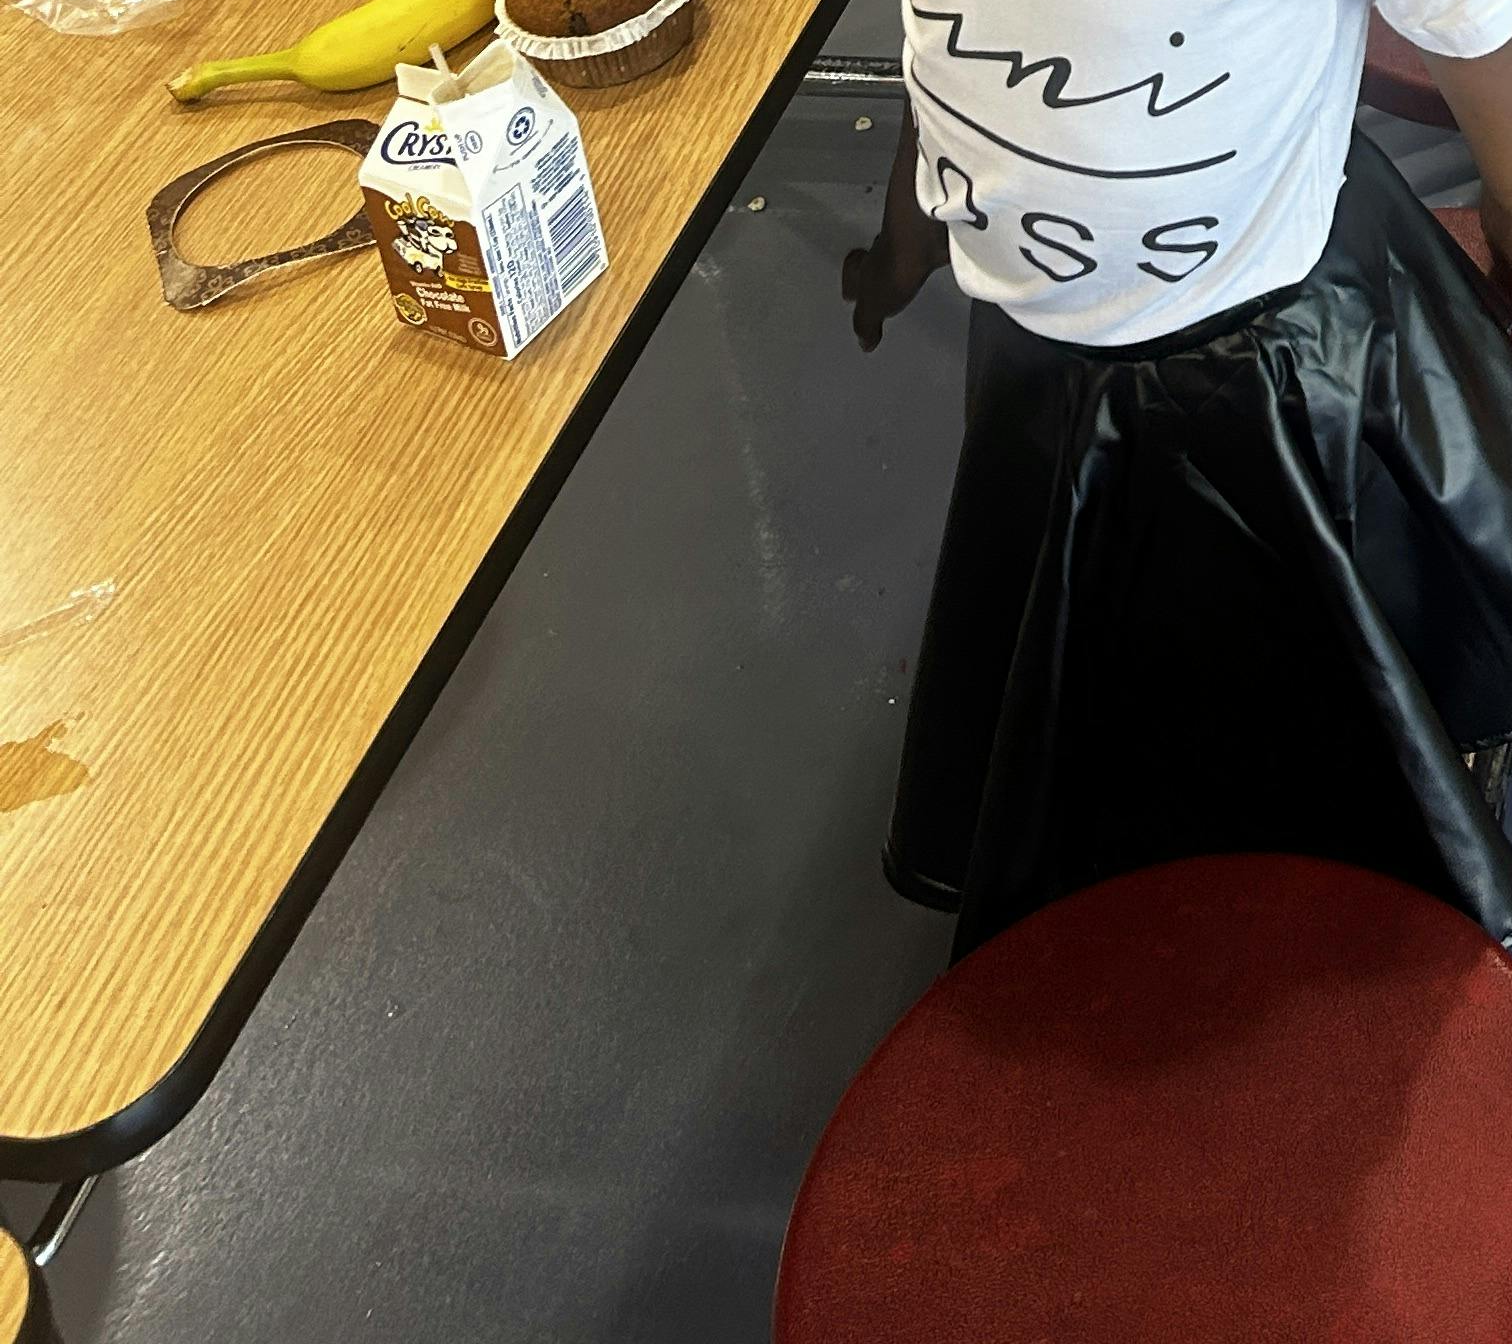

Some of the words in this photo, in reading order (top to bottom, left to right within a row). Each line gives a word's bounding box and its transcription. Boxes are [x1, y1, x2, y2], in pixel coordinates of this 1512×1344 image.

[380, 120, 453, 165] CRYS
[384, 191, 415, 221] Cool
[415, 286, 466, 304] Chocolate
